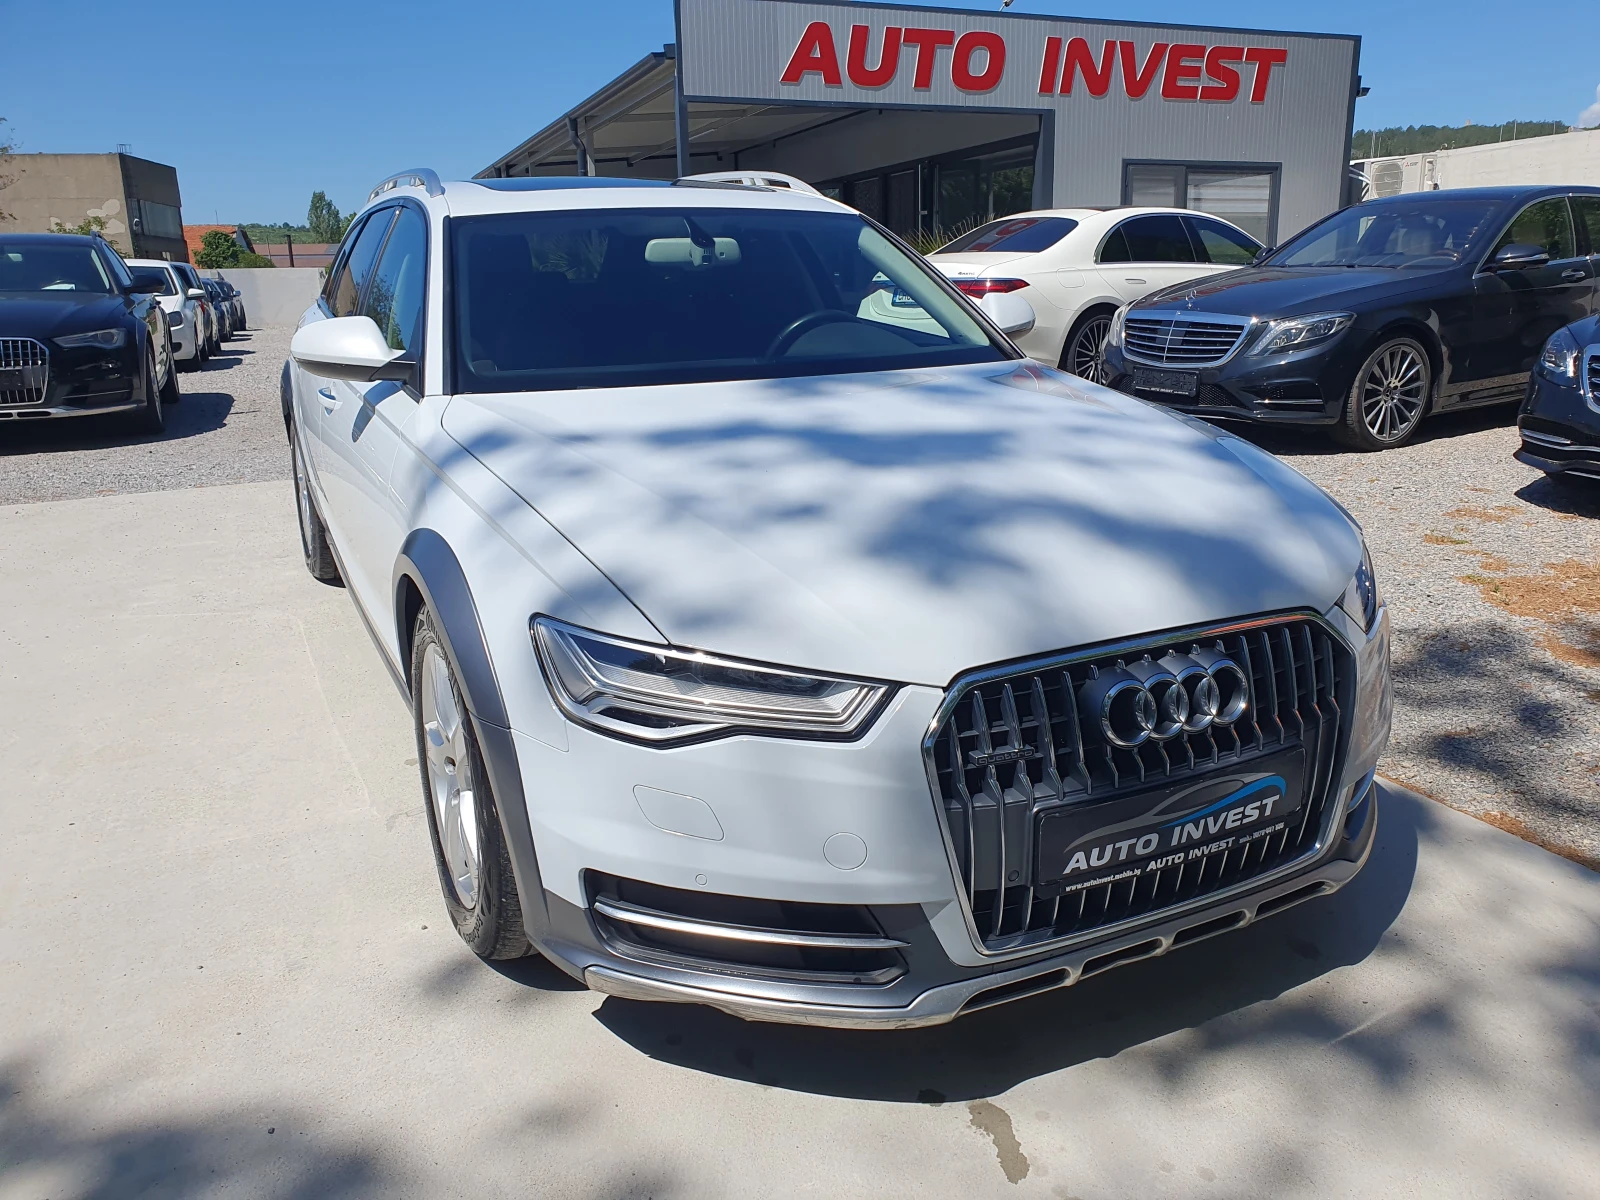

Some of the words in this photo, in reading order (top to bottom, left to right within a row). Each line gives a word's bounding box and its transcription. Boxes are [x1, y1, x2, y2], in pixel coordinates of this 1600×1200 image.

[781, 21, 1006, 91] AUTO
[1039, 37, 1288, 104] INVEST
[978, 750, 1033, 766] quattro
[1062, 832, 1159, 875] AUTO
[1170, 795, 1280, 847] INVEST
[1145, 852, 1185, 872] AUTO
[1188, 836, 1236, 860] INVEST
